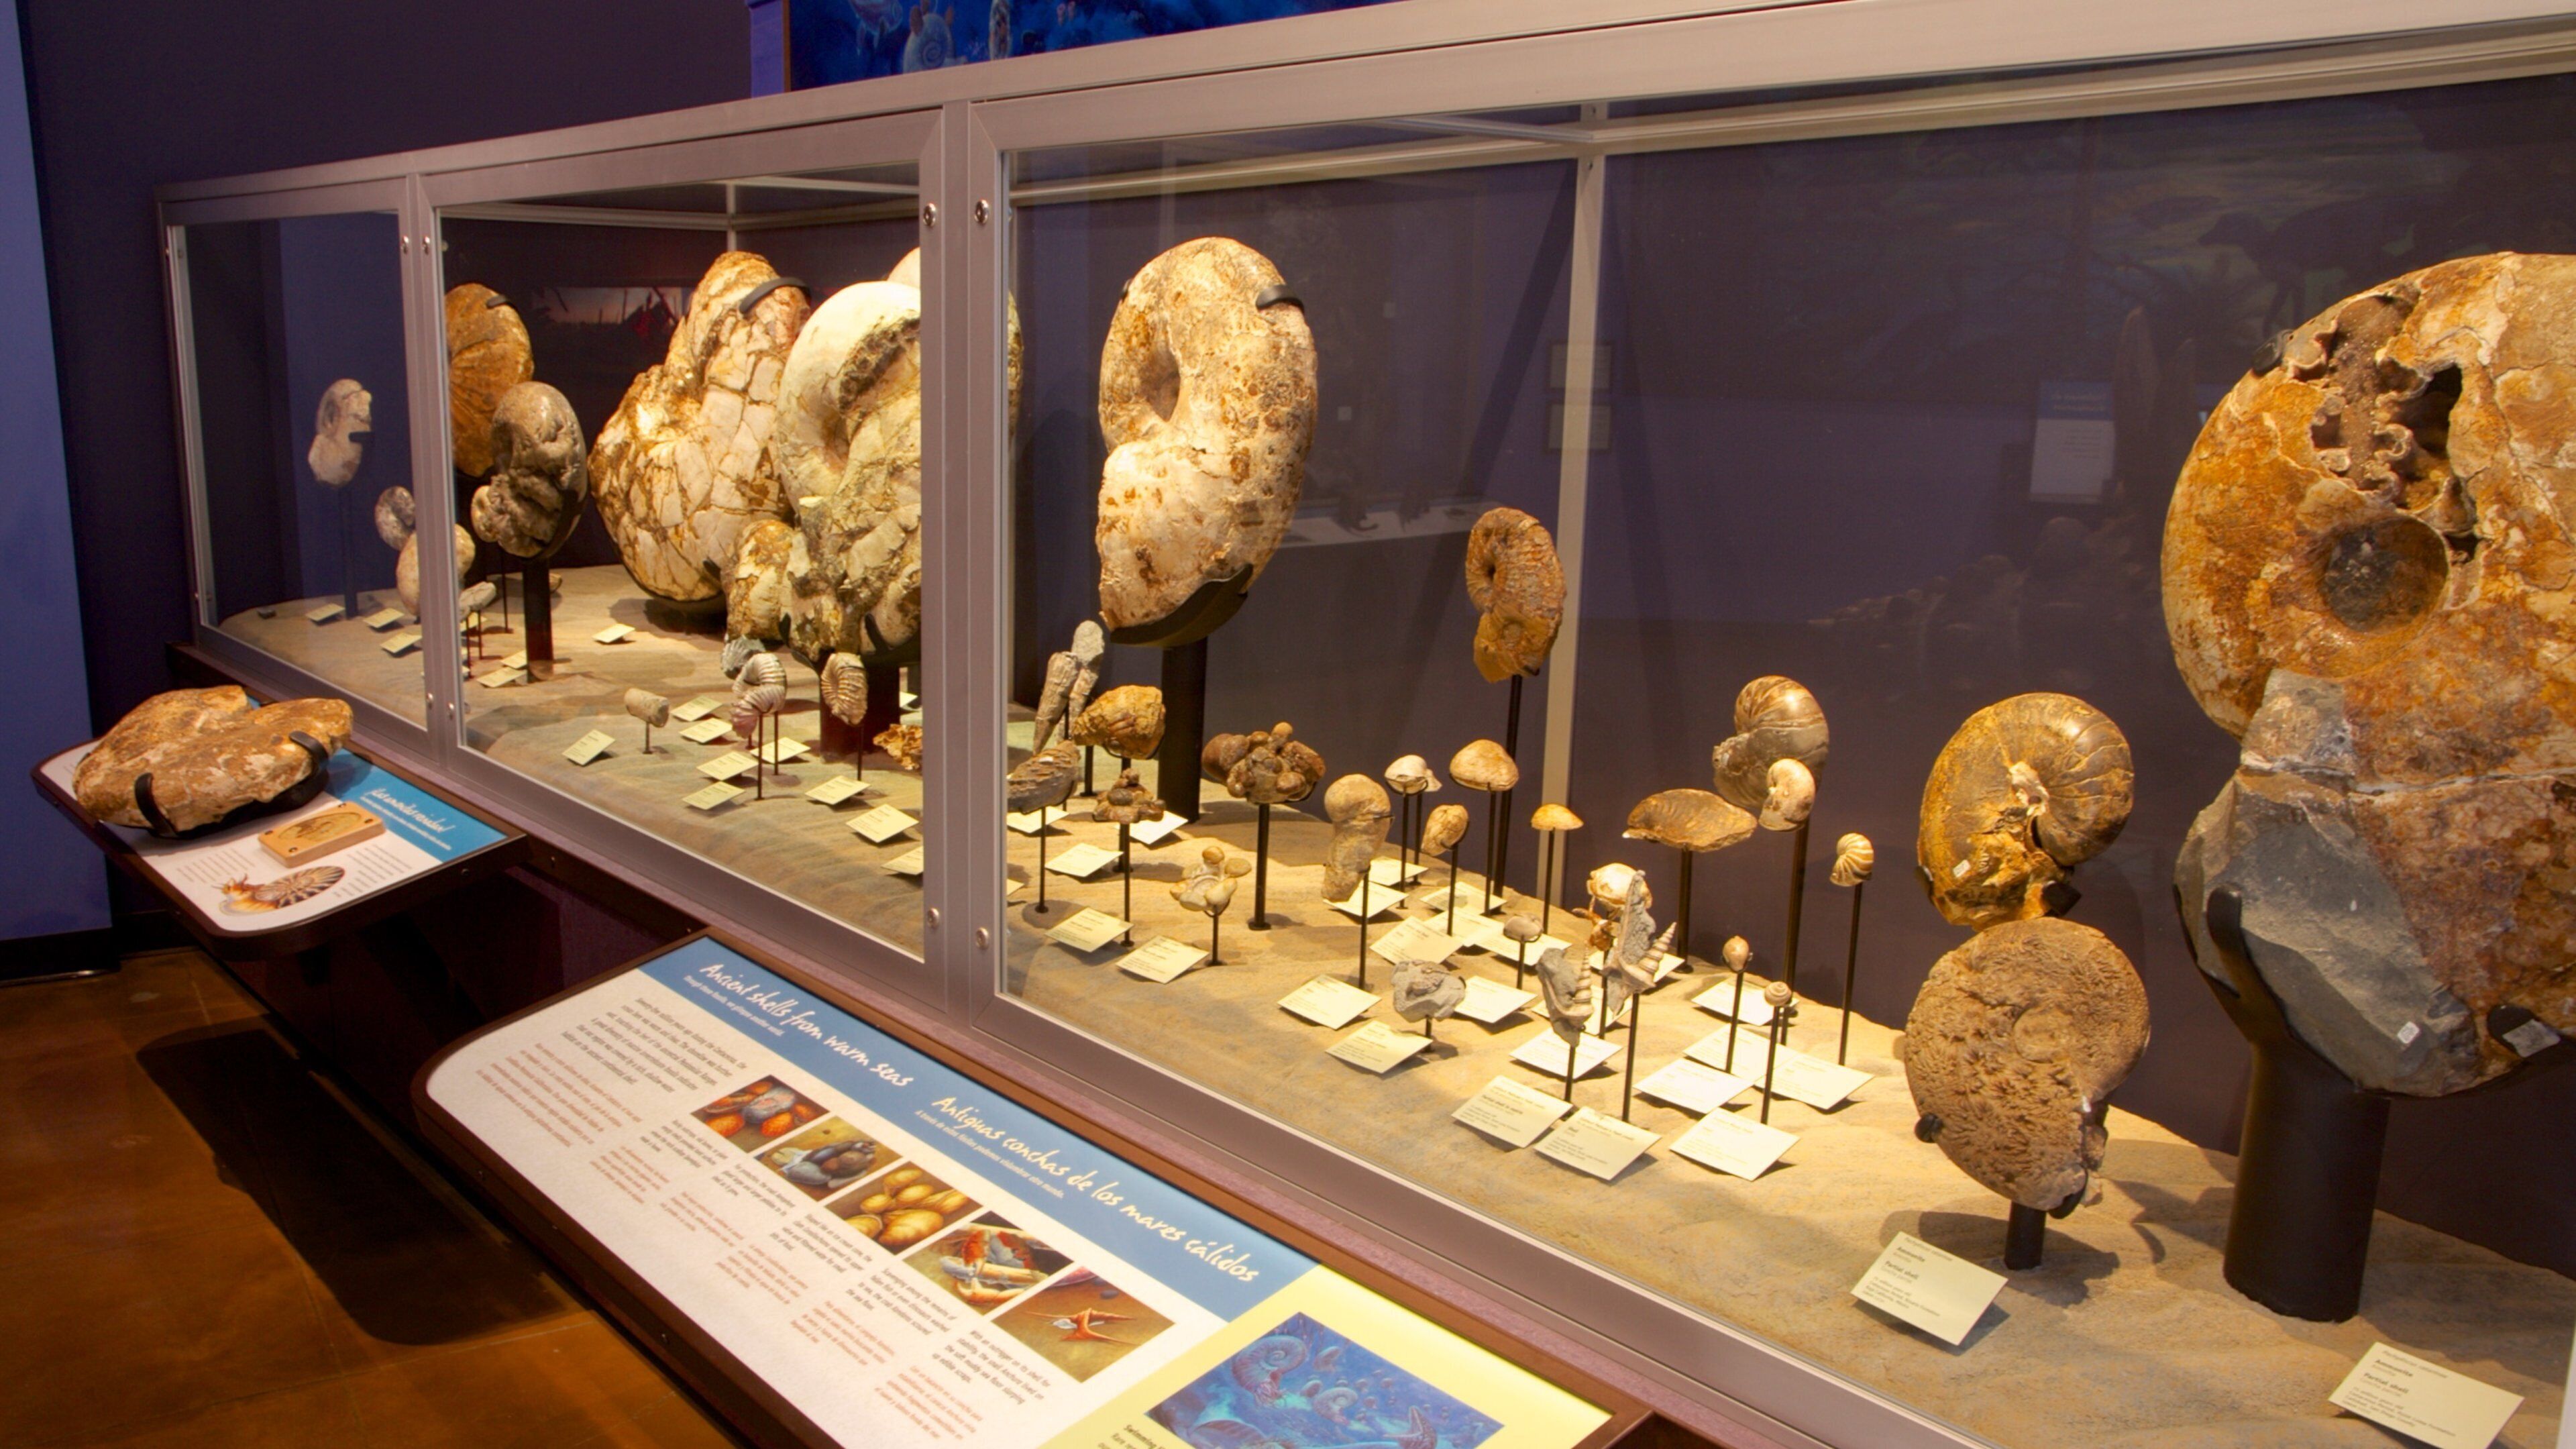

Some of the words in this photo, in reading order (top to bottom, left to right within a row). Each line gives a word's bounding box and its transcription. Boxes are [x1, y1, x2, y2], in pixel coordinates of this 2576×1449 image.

[699, 963, 759, 995] Ancient
[745, 991, 798, 1017] shells
[779, 1010, 823, 1039] from
[822, 1035, 869, 1066] warm
[869, 1062, 914, 1086] seas
[931, 1097, 1005, 1139] Antiguas
[1002, 1137, 1070, 1176] conchas
[1065, 1169, 1098, 1191] de
[1090, 1181, 1124, 1206] los
[1119, 1204, 1187, 1241] mares
[1184, 1239, 1258, 1281] cálidos
[938, 1358, 955, 1371] edible
[954, 1369, 971, 1383] scraps.
[944, 1344, 955, 1353] the
[953, 1351, 966, 1360] soft
[963, 1359, 981, 1373] muddy
[979, 1371, 991, 1379] sea
[989, 1376, 1004, 1388] floor
[1002, 1387, 1025, 1405] slurping
[957, 1338, 977, 1354] stability,
[978, 1352, 989, 1360] the
[987, 1360, 1003, 1371] snail
[1020, 1382, 1037, 1395] lived
[969, 1330, 983, 1340] With
[988, 1344, 1012, 1360] outrigger
[1019, 1364, 1028, 1373] its
[1026, 1371, 1042, 1382] shell
[1040, 1379, 1051, 1387] for
[1111, 1432, 1126, 1445] Rare
[1124, 1424, 1156, 1449] Swimming
